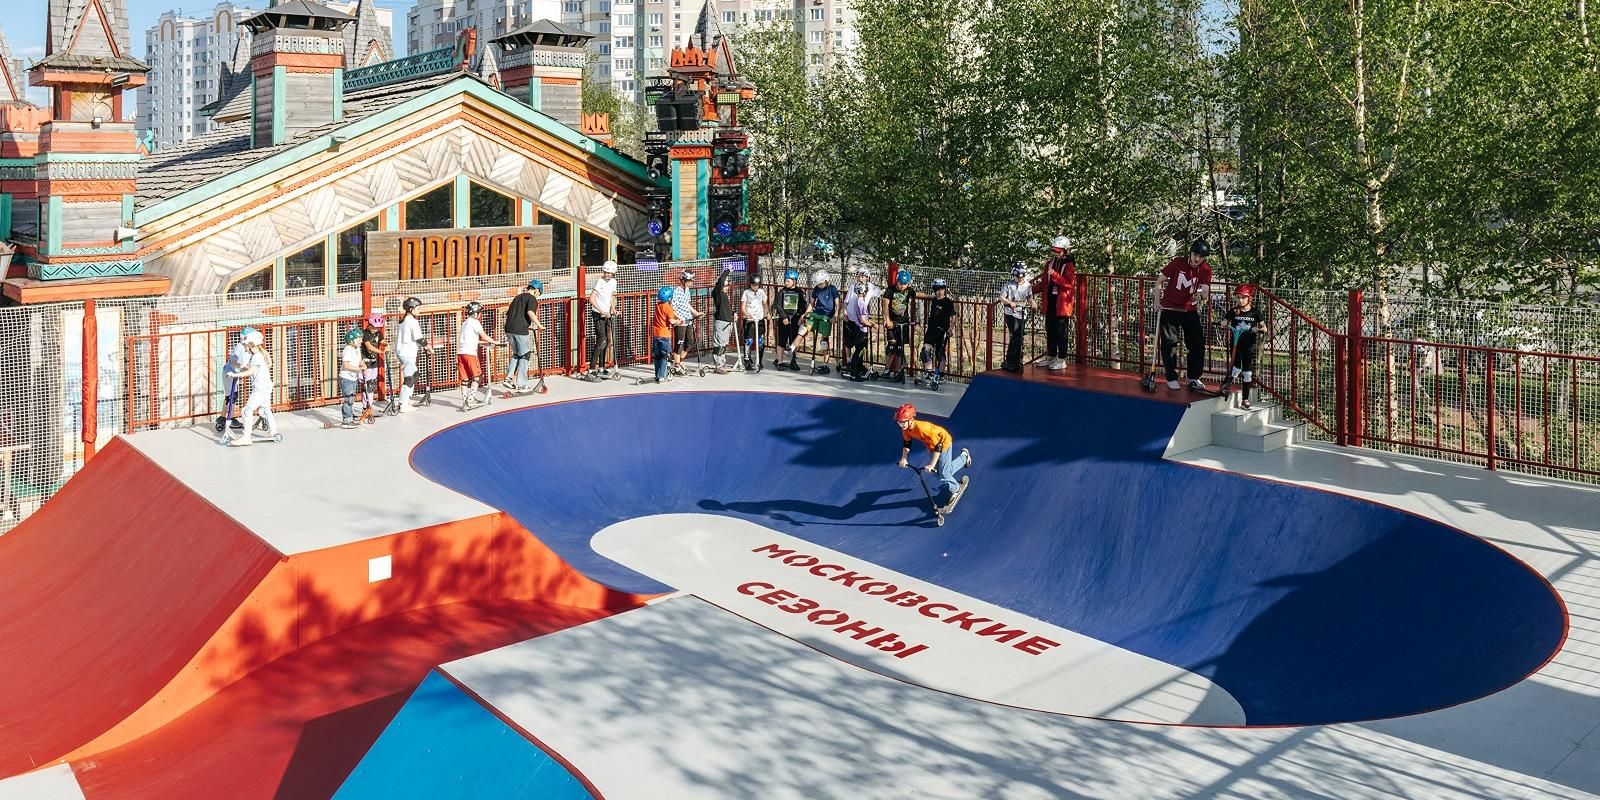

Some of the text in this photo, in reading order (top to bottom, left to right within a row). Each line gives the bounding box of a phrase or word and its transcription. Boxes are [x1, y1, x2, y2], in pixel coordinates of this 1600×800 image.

[399, 233, 533, 281] ПРОКАТ
[736, 582, 930, 659] СЕЗОНЫ
[751, 543, 1062, 656] МОСКОВСКИЕ
